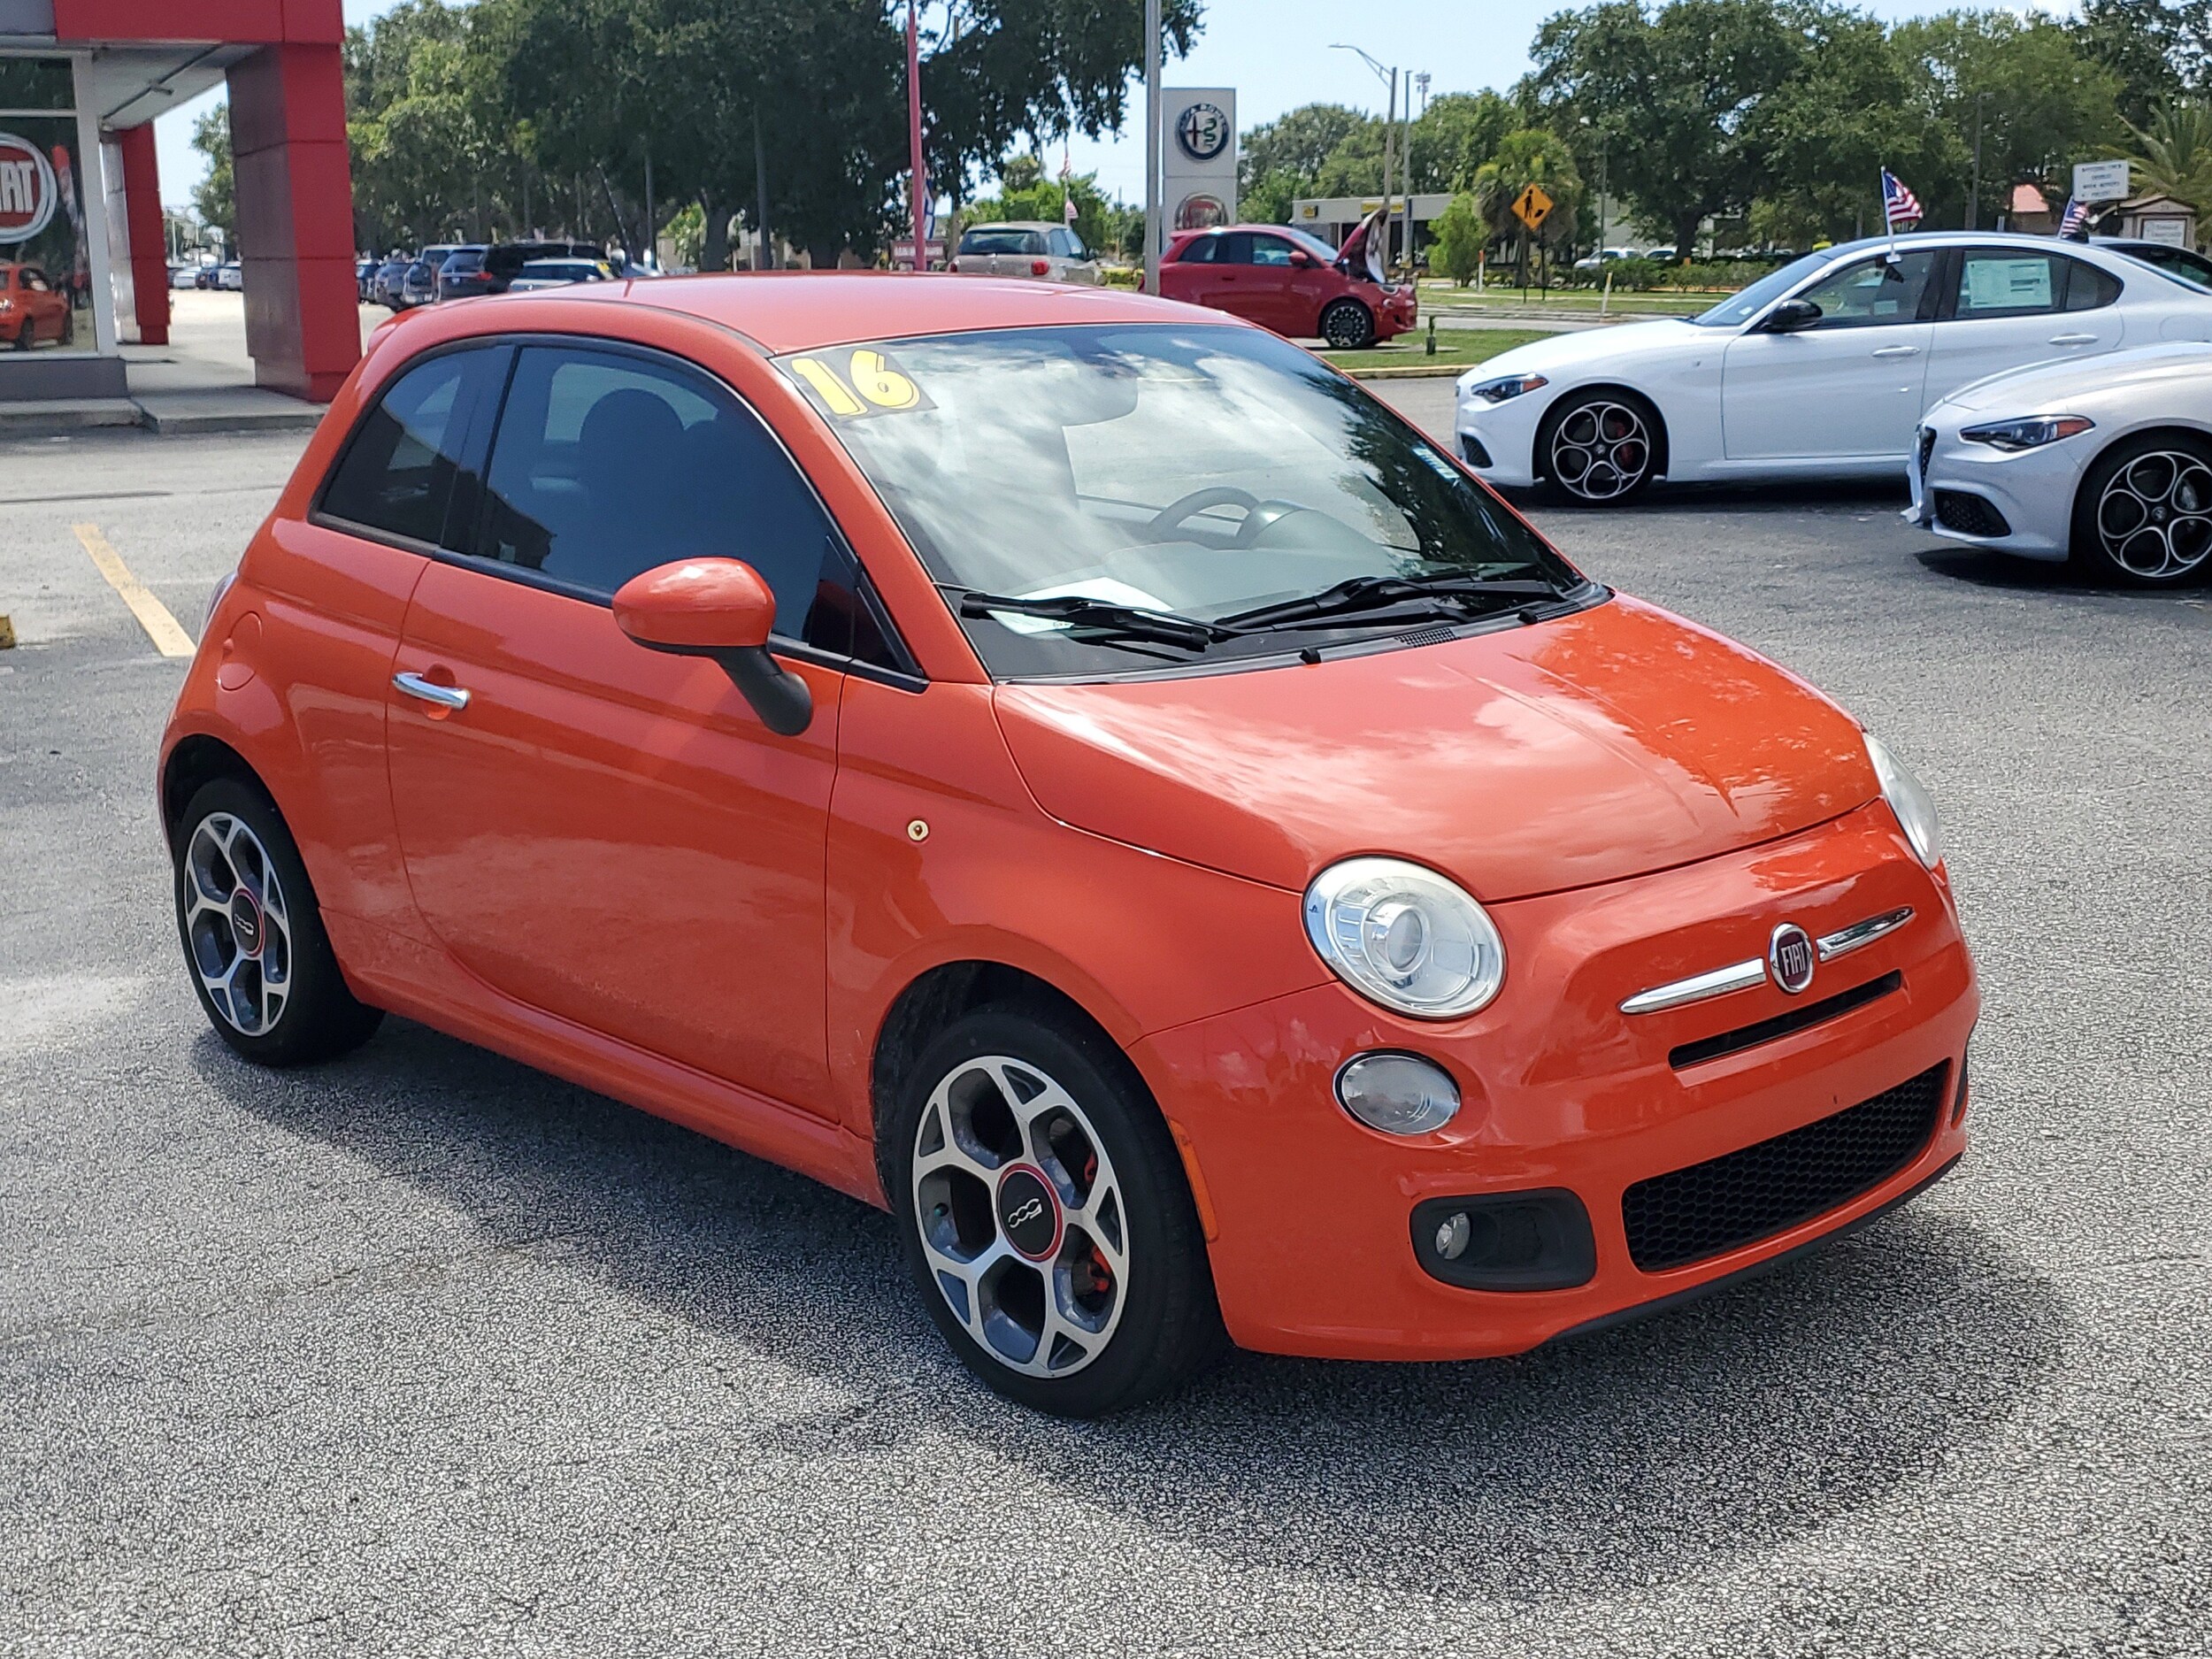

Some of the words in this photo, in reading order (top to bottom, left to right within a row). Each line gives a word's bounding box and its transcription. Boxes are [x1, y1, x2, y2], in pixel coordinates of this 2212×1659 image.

[0, 160, 35, 212] AT
[791, 349, 921, 417] 16
[1780, 941, 1806, 977] FIAT
